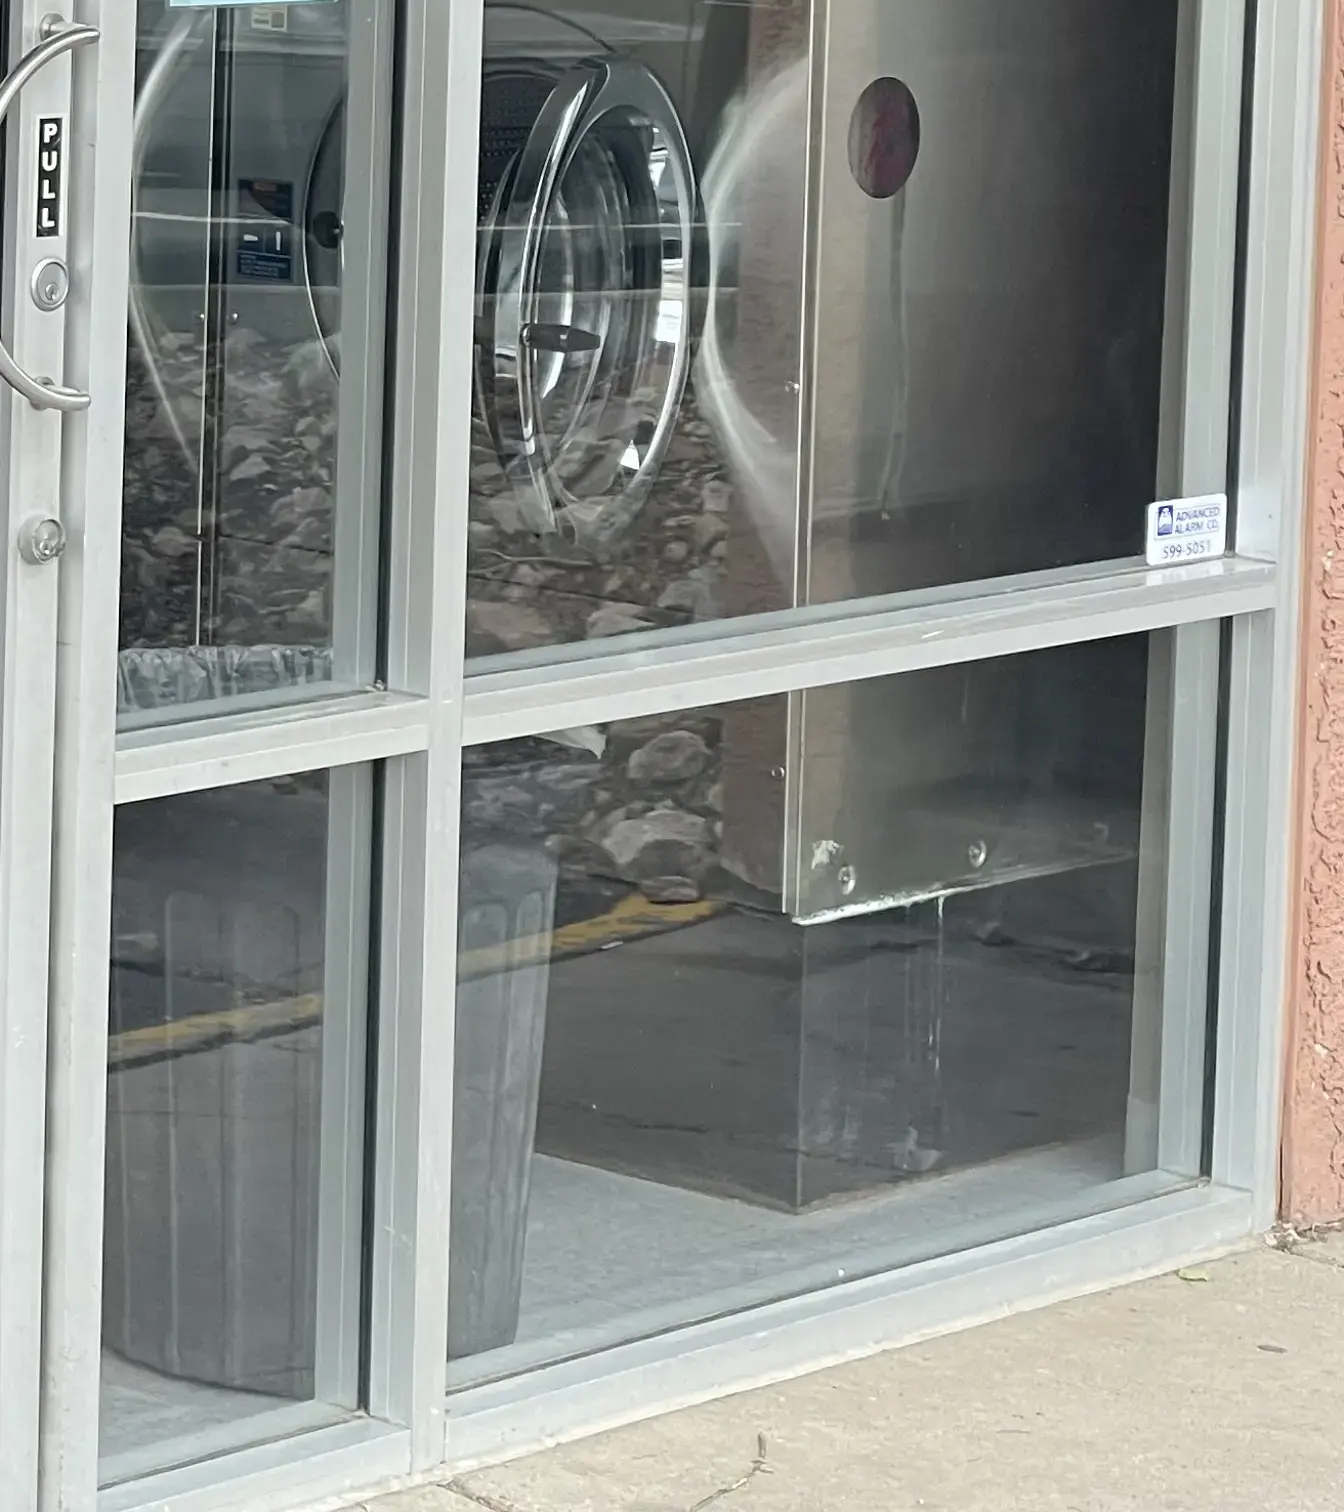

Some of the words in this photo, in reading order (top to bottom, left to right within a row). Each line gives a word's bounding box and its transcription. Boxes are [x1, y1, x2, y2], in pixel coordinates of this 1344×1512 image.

[41, 123, 59, 228] PULL
[1175, 506, 1220, 522] ADVANCED
[1174, 522, 1204, 534] ALARM
[1162, 540, 1212, 559] 599-5051
